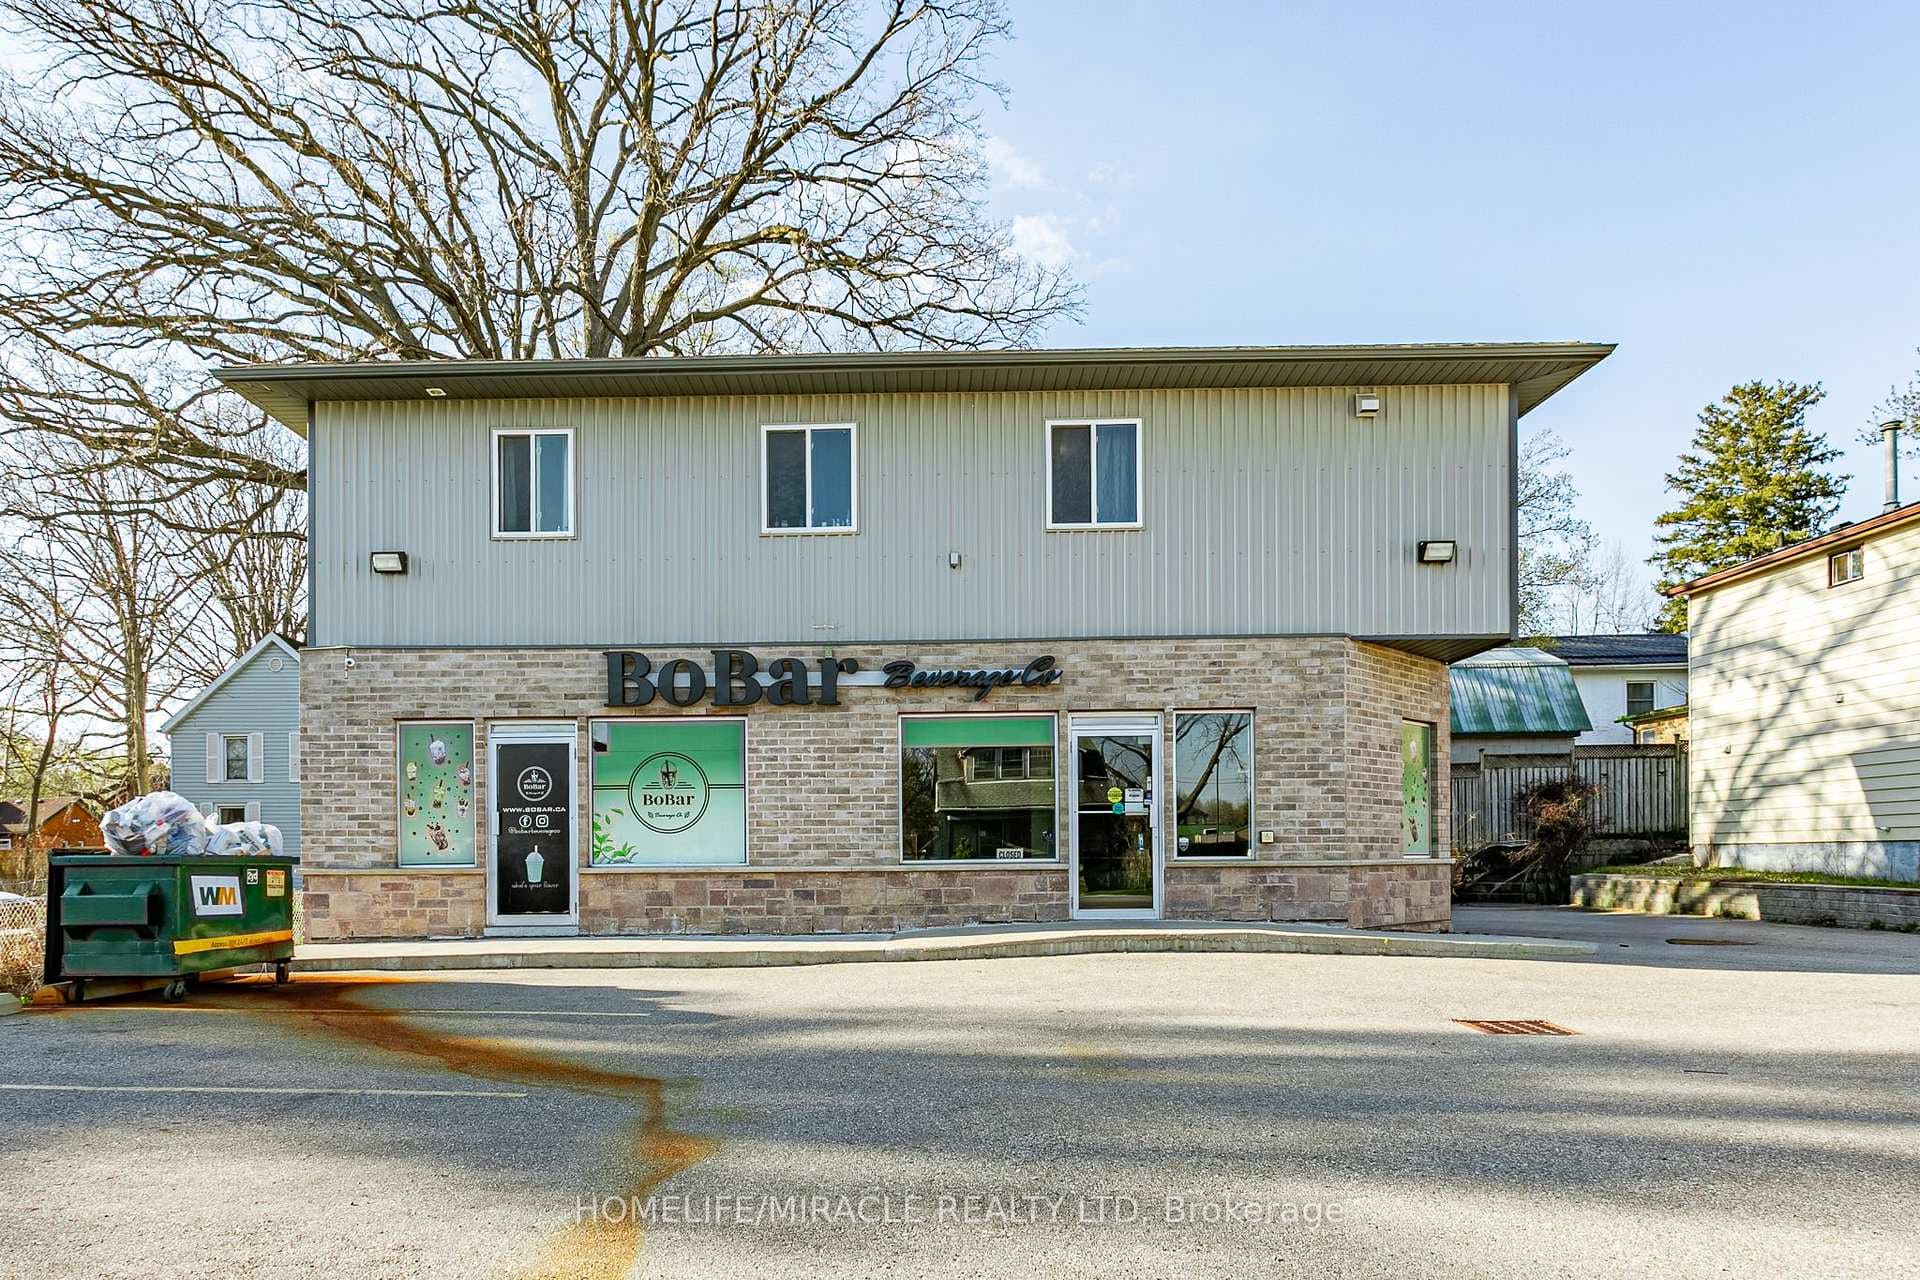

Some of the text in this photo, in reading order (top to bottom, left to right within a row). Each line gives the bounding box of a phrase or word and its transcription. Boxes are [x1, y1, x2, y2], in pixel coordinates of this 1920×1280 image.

[603, 649, 1063, 708] BoBar Beverage Co
[643, 793, 695, 806] BoBar
[998, 850, 1022, 859] CLOSED
[199, 886, 238, 906] WM
